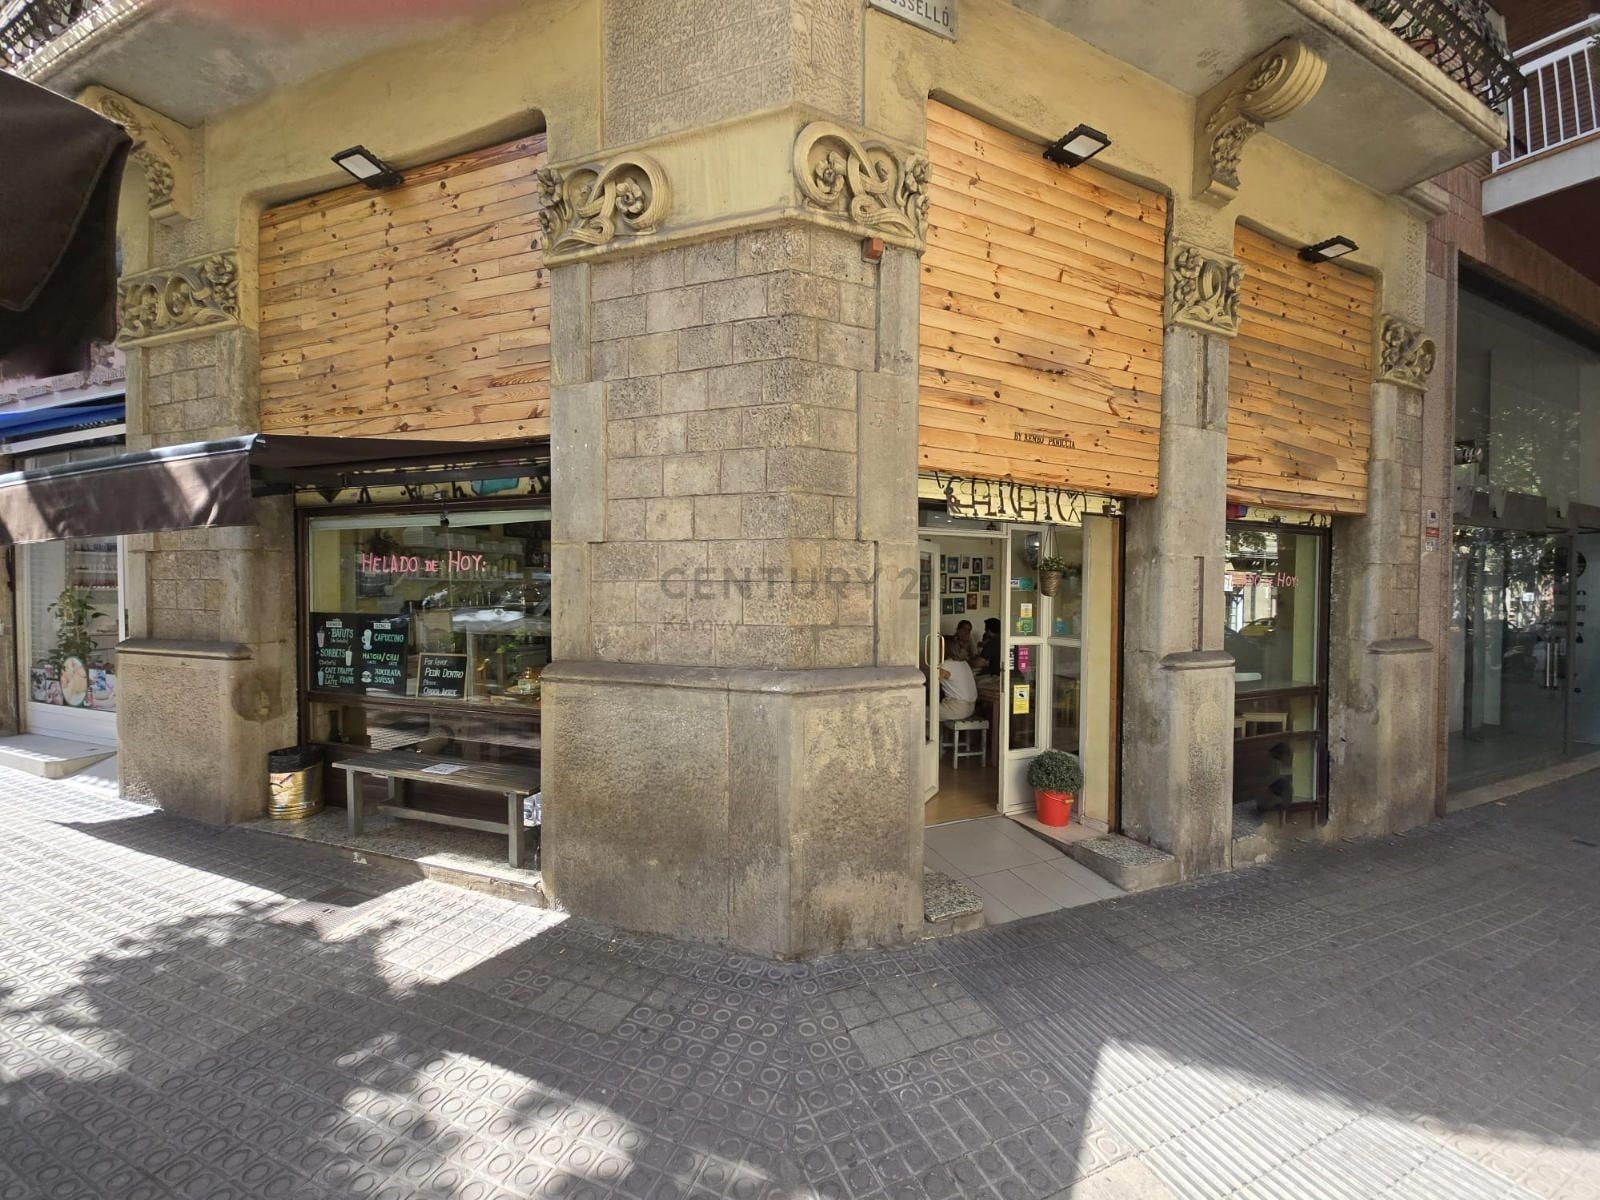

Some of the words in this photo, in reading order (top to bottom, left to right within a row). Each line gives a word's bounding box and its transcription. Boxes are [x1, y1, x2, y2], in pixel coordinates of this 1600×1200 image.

[878, 0, 950, 27] SSELLÓ
[360, 551, 418, 573] HELADO
[424, 559, 439, 573] DE
[448, 550, 487, 573] HOY:
